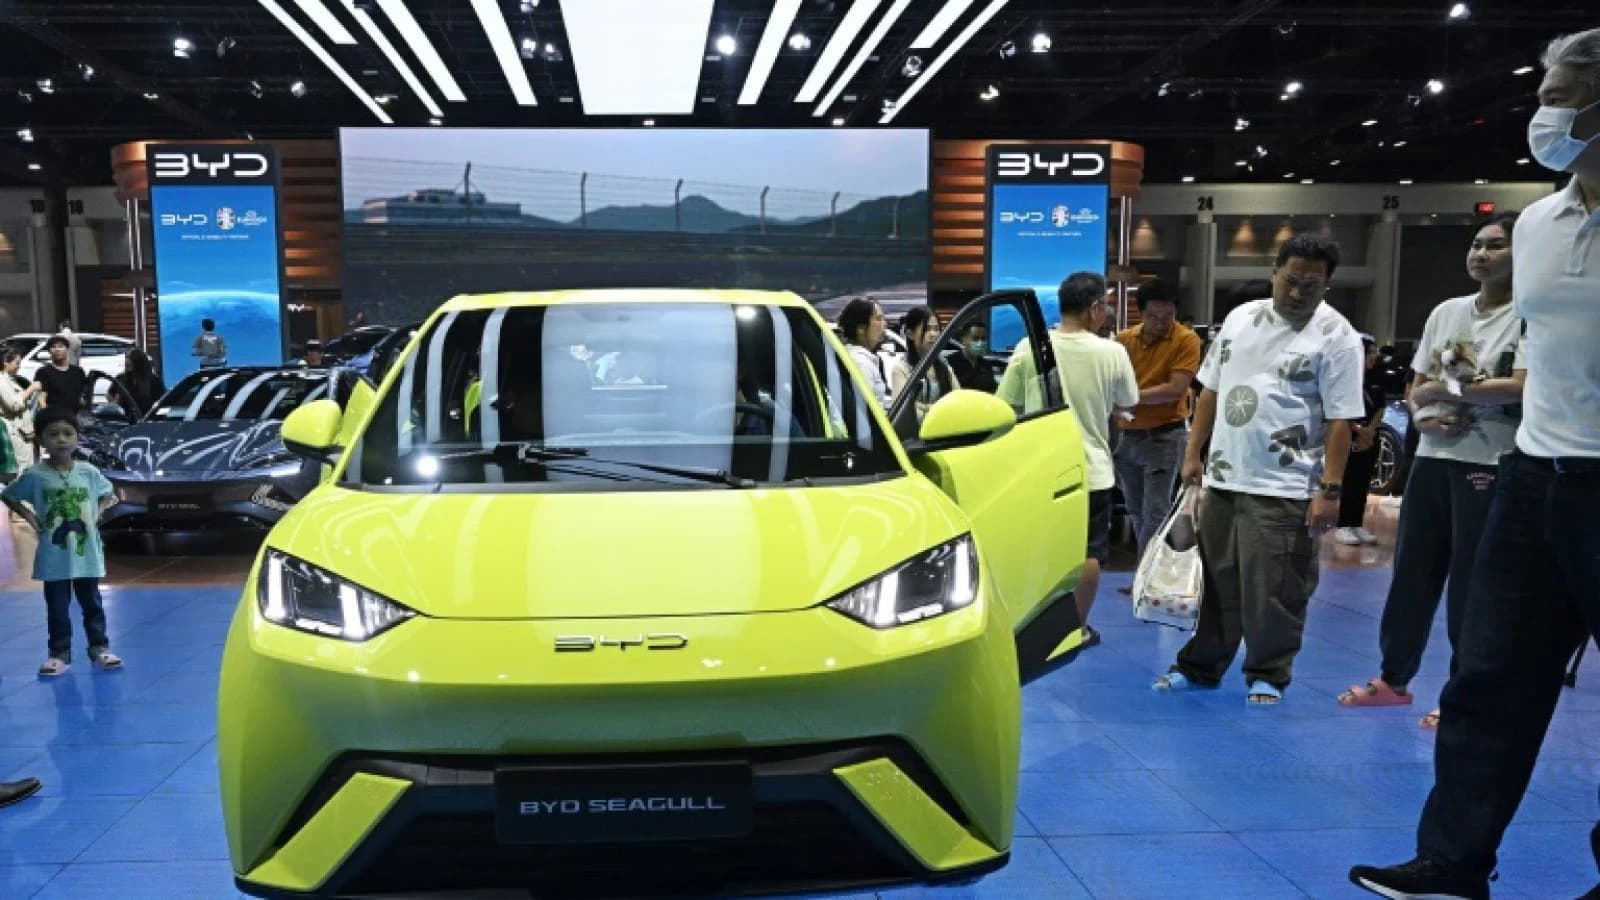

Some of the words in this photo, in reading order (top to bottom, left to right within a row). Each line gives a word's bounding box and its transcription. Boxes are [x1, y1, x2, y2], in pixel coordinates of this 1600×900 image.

[154, 153, 269, 178] BYD
[997, 153, 1105, 177] BYD
[1197, 196, 1213, 211] 24
[1383, 195, 1400, 209] 25
[161, 213, 208, 226] BYD
[999, 211, 1044, 224] BYD
[554, 633, 688, 653] BYD
[520, 800, 580, 815] BYD
[588, 797, 726, 813] SEAGULL
